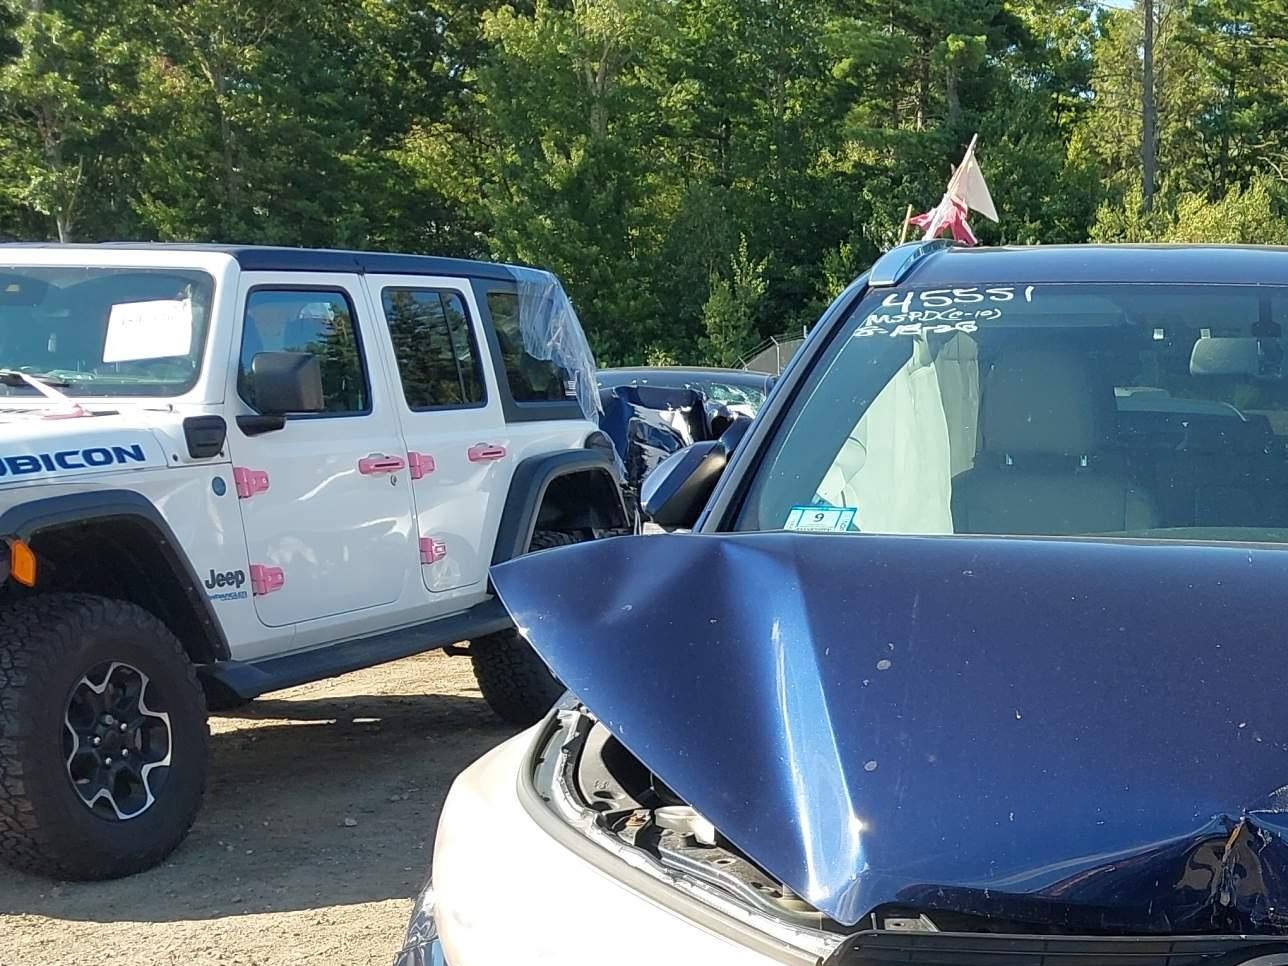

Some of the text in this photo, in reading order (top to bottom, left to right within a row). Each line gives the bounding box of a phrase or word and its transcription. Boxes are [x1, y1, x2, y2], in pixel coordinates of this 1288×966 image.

[881, 285, 1035, 313] 45551
[0, 444, 146, 477] BICON
[205, 569, 246, 589] Jeep
